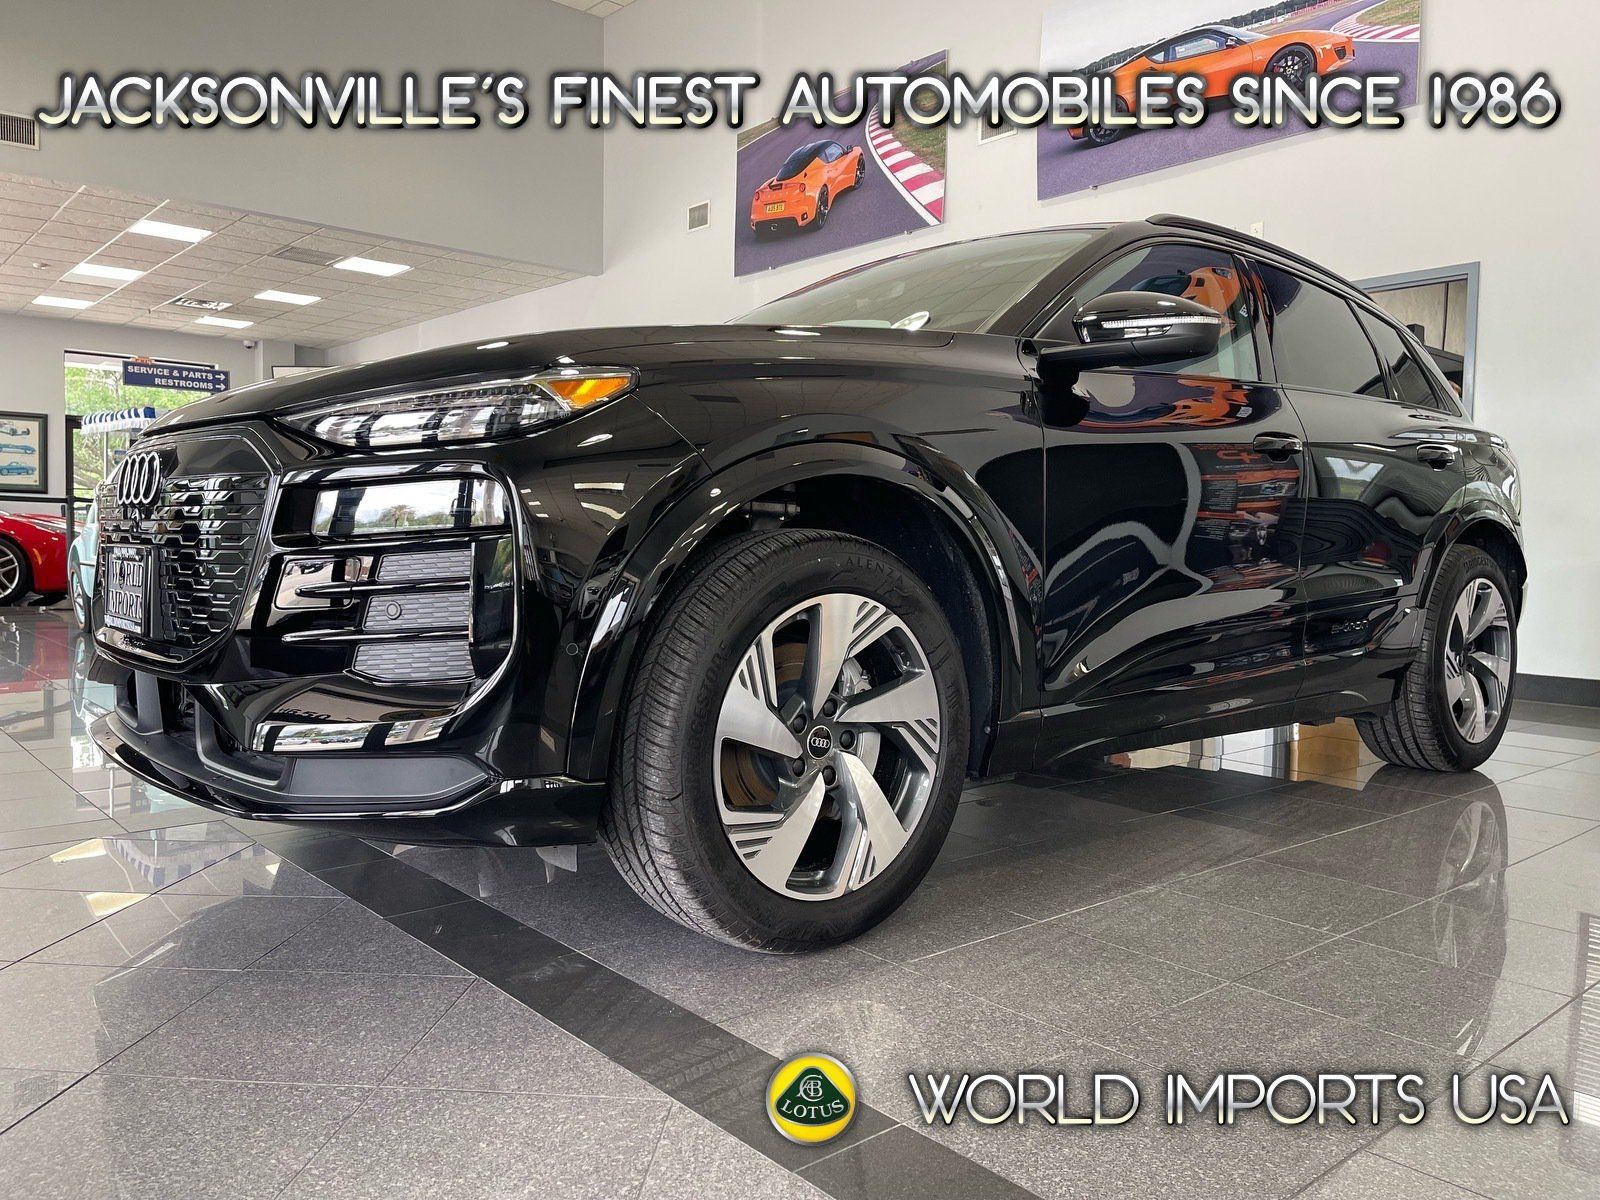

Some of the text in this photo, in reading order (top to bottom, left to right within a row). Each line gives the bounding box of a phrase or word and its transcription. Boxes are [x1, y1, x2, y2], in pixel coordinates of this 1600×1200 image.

[127, 365, 214, 380] SERVICE & PARTS
[154, 377, 214, 390] RESTROOMS
[846, 555, 904, 585] ALENZA
